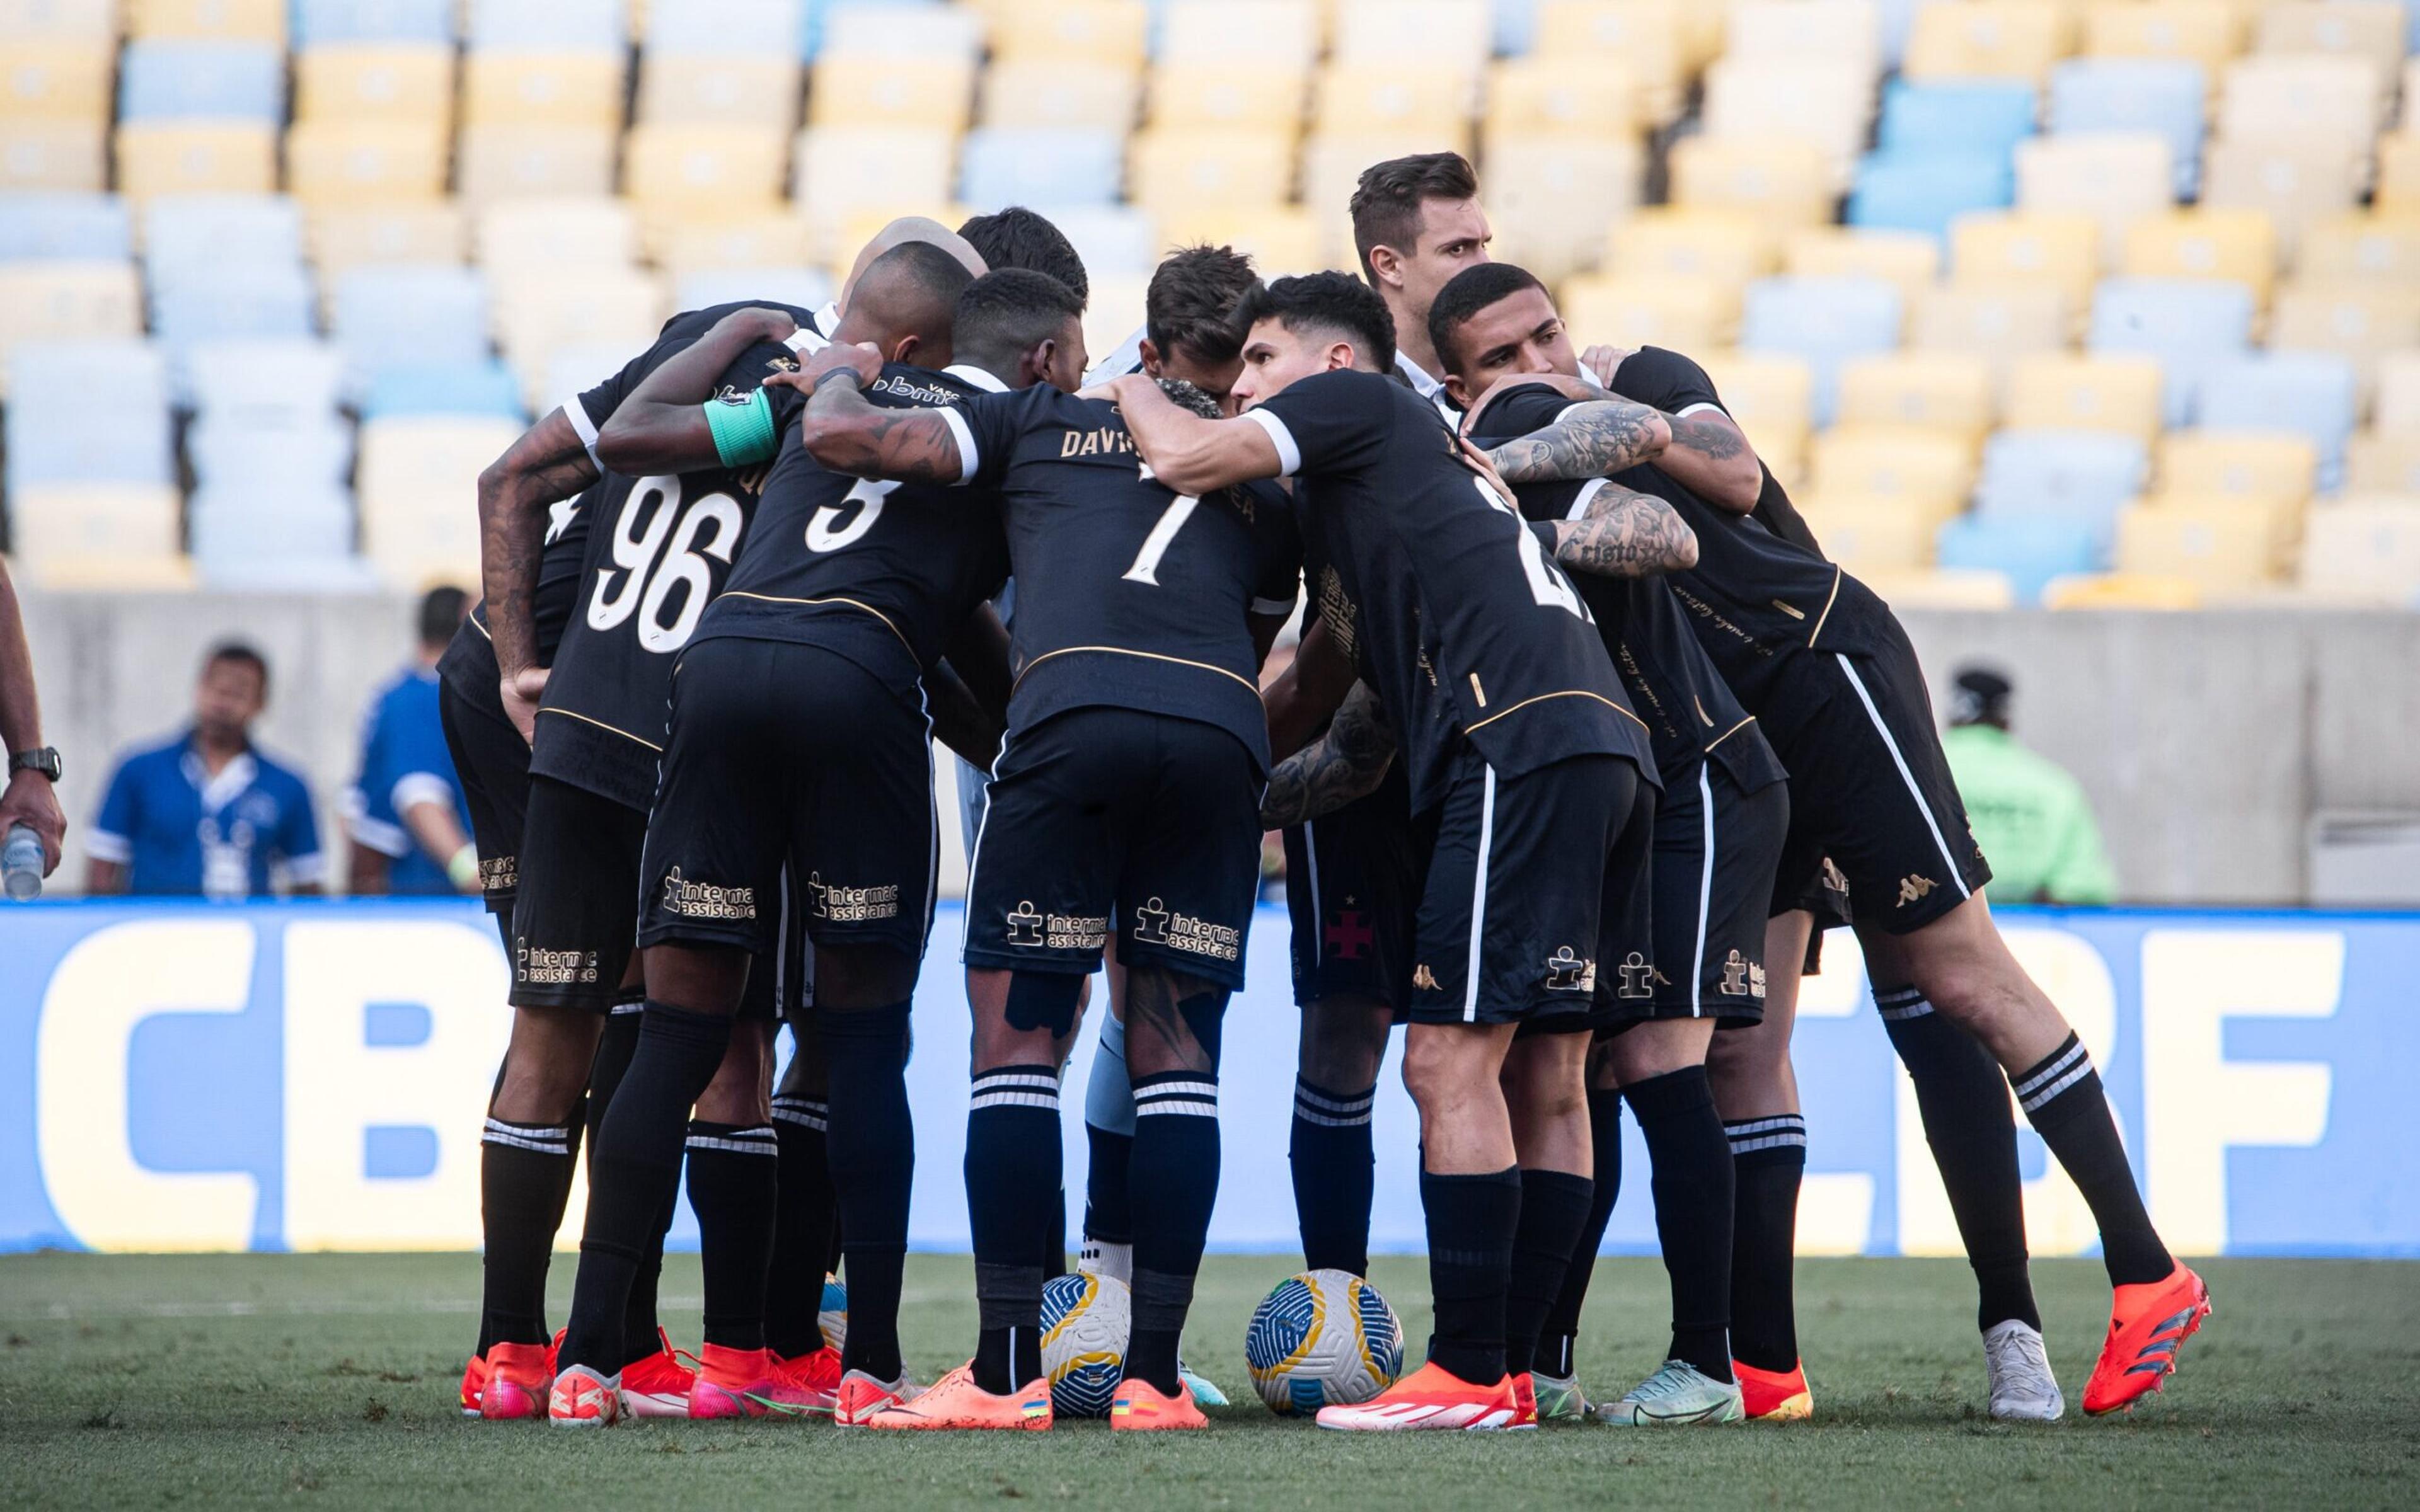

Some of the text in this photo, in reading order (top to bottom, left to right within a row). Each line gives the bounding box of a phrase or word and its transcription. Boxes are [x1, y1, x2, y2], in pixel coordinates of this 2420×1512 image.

[1060, 426, 1141, 458] DAVI
[1121, 462, 1200, 587] 7
[587, 473, 743, 654] 96
[682, 880, 754, 905] interma
[827, 884, 898, 906] intermac
[681, 901, 756, 919] assistanc
[829, 903, 898, 921] assistance
[1047, 914, 1107, 934] interma
[1047, 932, 1108, 949] assistanc
[1168, 933, 1238, 961] assistace
[530, 947, 597, 968] intermc
[529, 965, 597, 983] assistace
